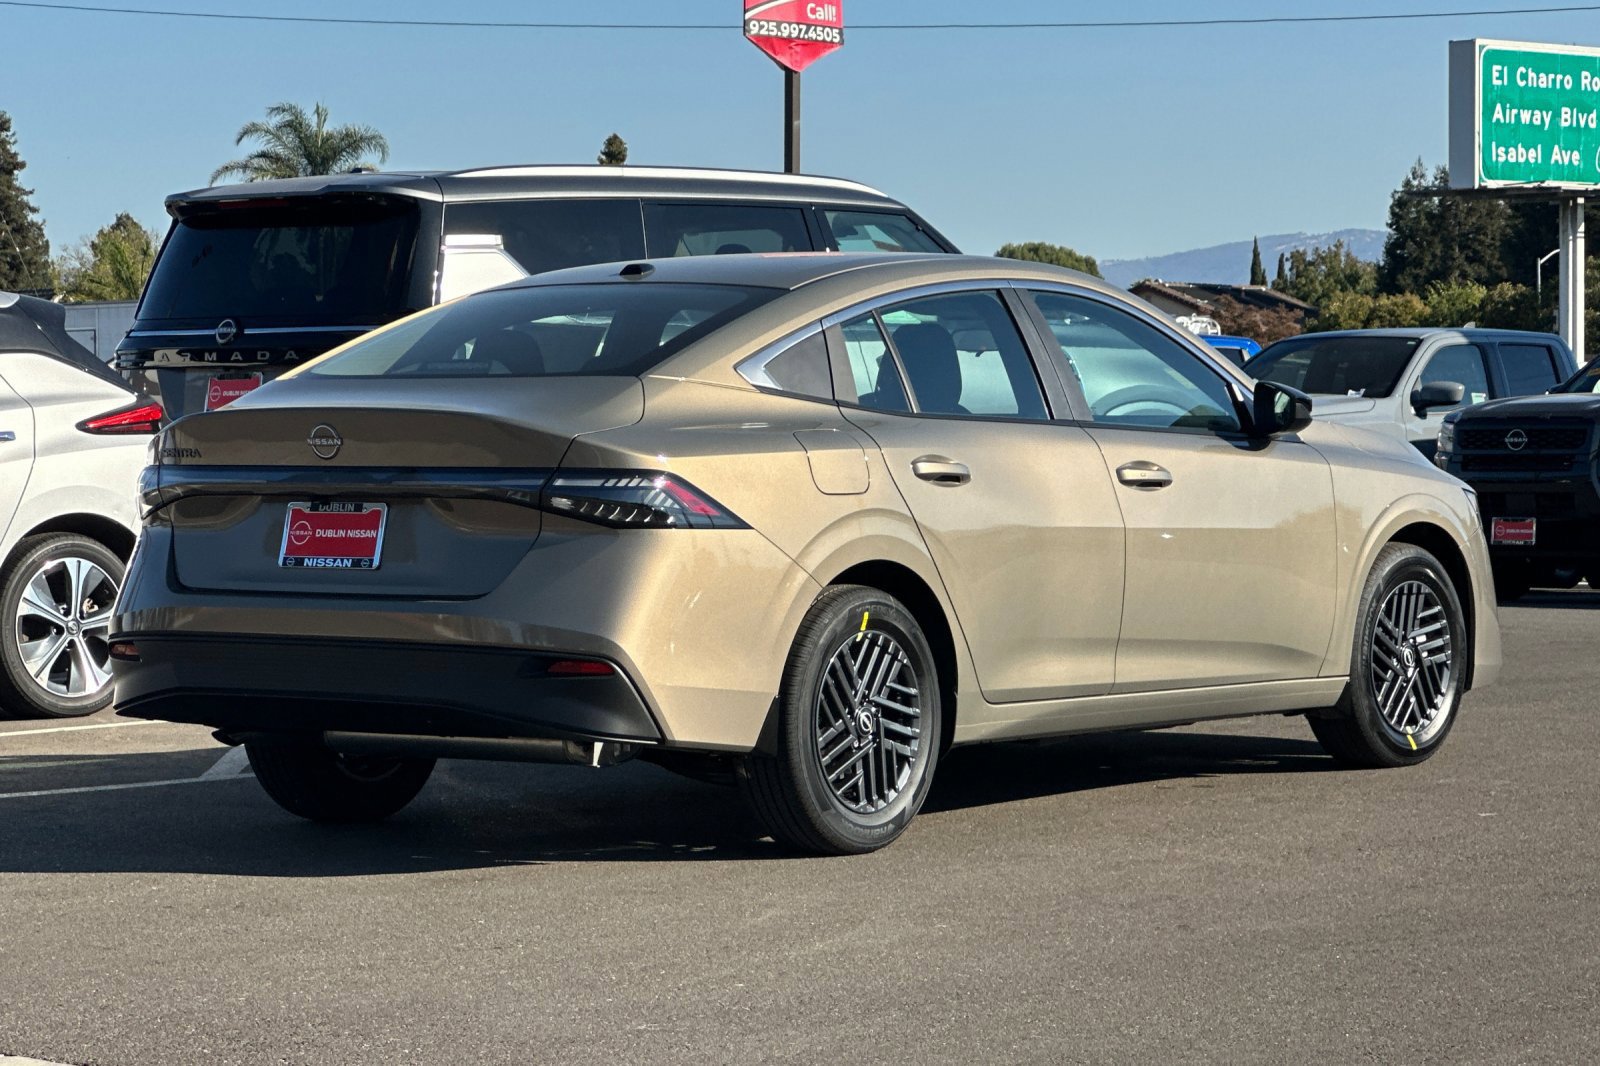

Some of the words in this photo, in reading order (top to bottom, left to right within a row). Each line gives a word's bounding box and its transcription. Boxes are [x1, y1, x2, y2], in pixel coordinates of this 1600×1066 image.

[806, 3, 836, 22] Call!
[749, 20, 840, 43] 925.997.4505
[1492, 65, 1508, 86] El
[1516, 66, 1573, 90] Charro
[1492, 103, 1552, 130] Airway
[1561, 107, 1597, 129] Blvd
[1491, 141, 1542, 163] Isabel
[1551, 144, 1580, 166] Ave
[307, 437, 341, 446] NISSAN
[315, 529, 346, 538] DUBLIN
[347, 530, 377, 538] NISSAN
[303, 558, 352, 567] NISSAN
